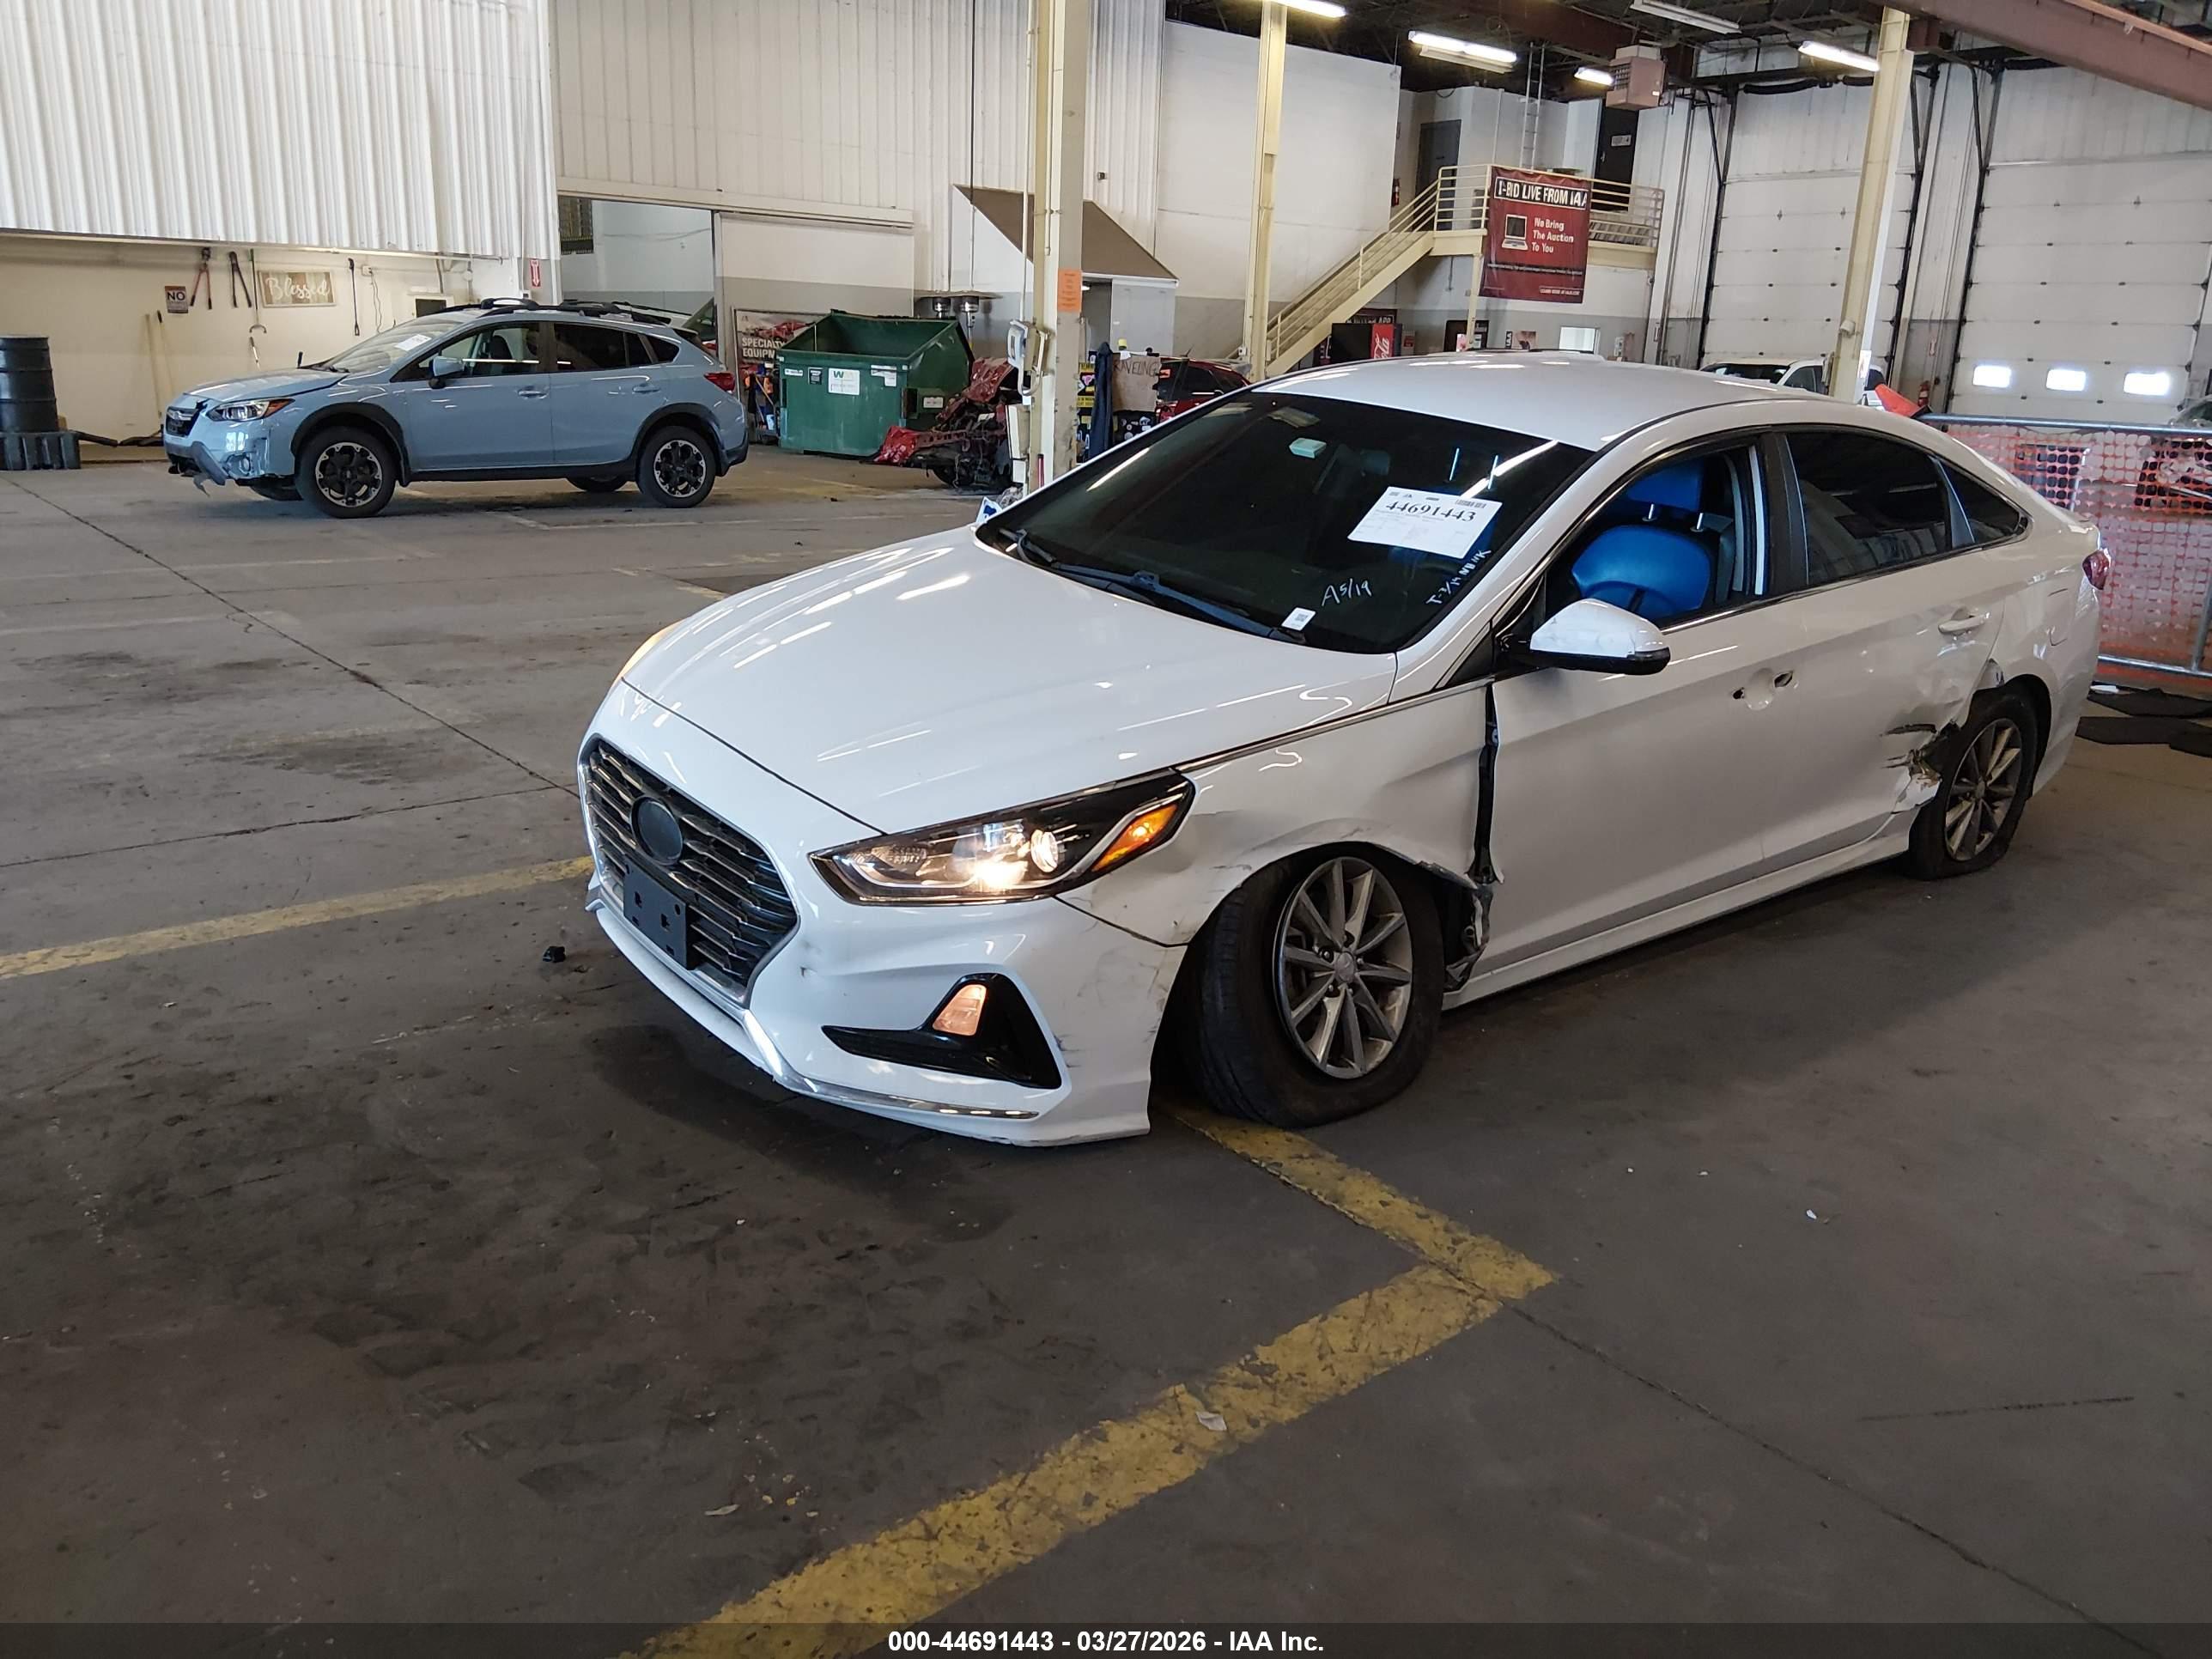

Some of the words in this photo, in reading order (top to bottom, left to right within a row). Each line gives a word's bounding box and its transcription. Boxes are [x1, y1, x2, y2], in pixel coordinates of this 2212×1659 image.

[1498, 180, 1520, 198] I-BID
[1522, 185, 1541, 201] LIVE
[1543, 187, 1568, 204] FROM
[1546, 219, 1565, 231] Bring
[1533, 230, 1546, 240] The
[1547, 232, 1574, 243] Auction
[1531, 241, 1540, 252] To
[1541, 242, 1554, 253] You
[264, 276, 331, 301] Blessed
[167, 291, 185, 301] NO
[742, 337, 785, 349] SPECIALTY
[1385, 501, 1477, 523] 44691443
